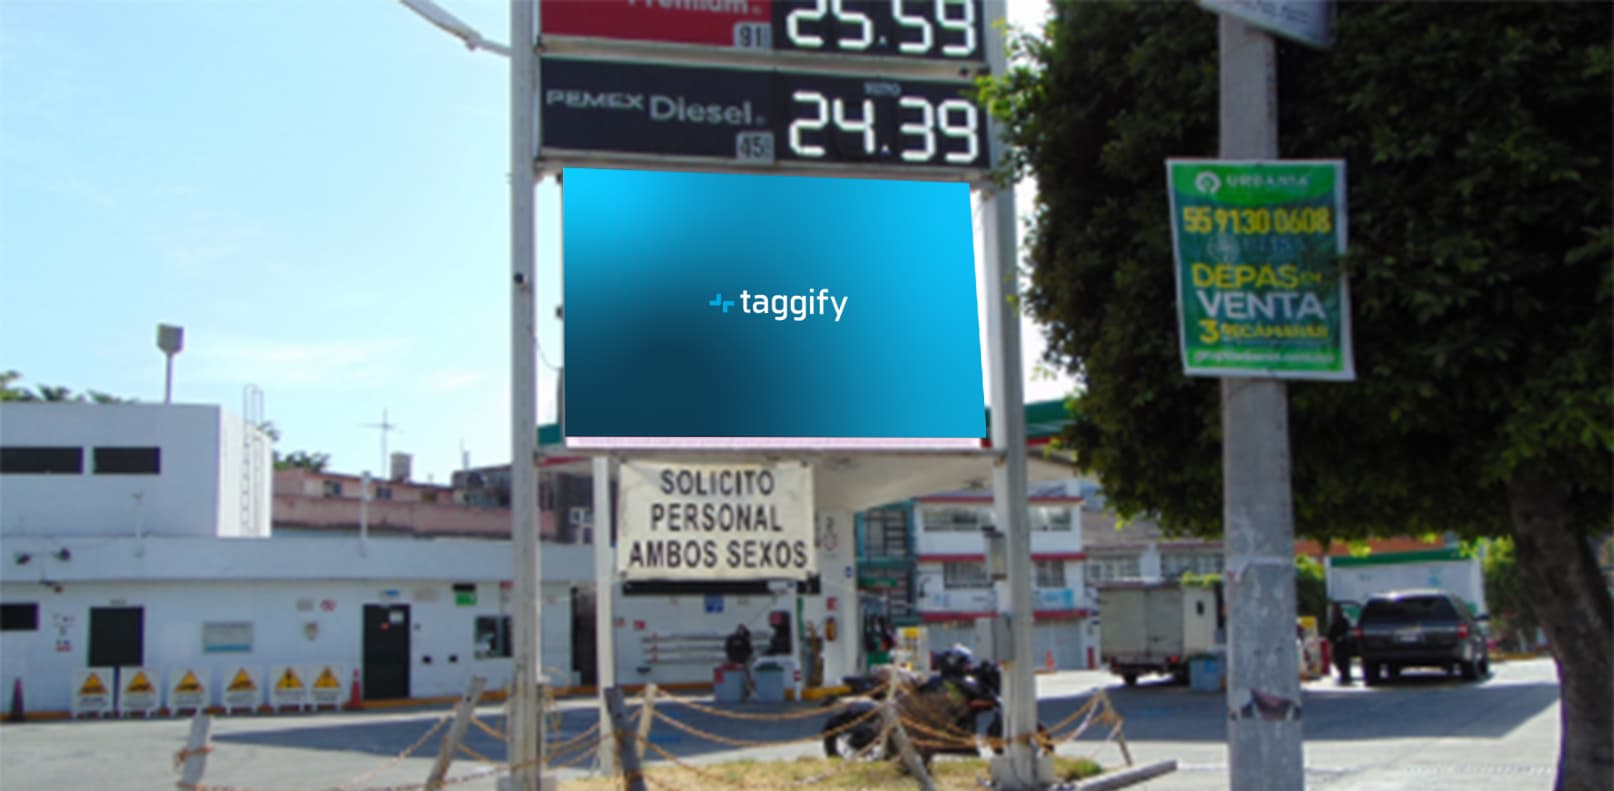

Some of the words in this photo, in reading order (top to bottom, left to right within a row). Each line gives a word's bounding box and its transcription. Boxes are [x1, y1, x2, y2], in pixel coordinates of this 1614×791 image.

[786, 0, 976, 57] 25.59
[546, 89, 644, 110] PEMEX
[650, 95, 752, 125] Diesel
[789, 91, 979, 163] 24.39
[1183, 206, 1213, 234] 55
[1215, 208, 1271, 235] 9130
[1274, 208, 1332, 234] 0608
[1191, 263, 1299, 289] DEPAS
[739, 287, 849, 323] taggify
[1196, 290, 1327, 320] VENTA
[1198, 319, 1220, 344] 3
[660, 468, 775, 496] SOLICITO
[651, 502, 783, 532] PERSONAL
[629, 540, 718, 569] AMBOS
[726, 540, 809, 569] SEXOS
